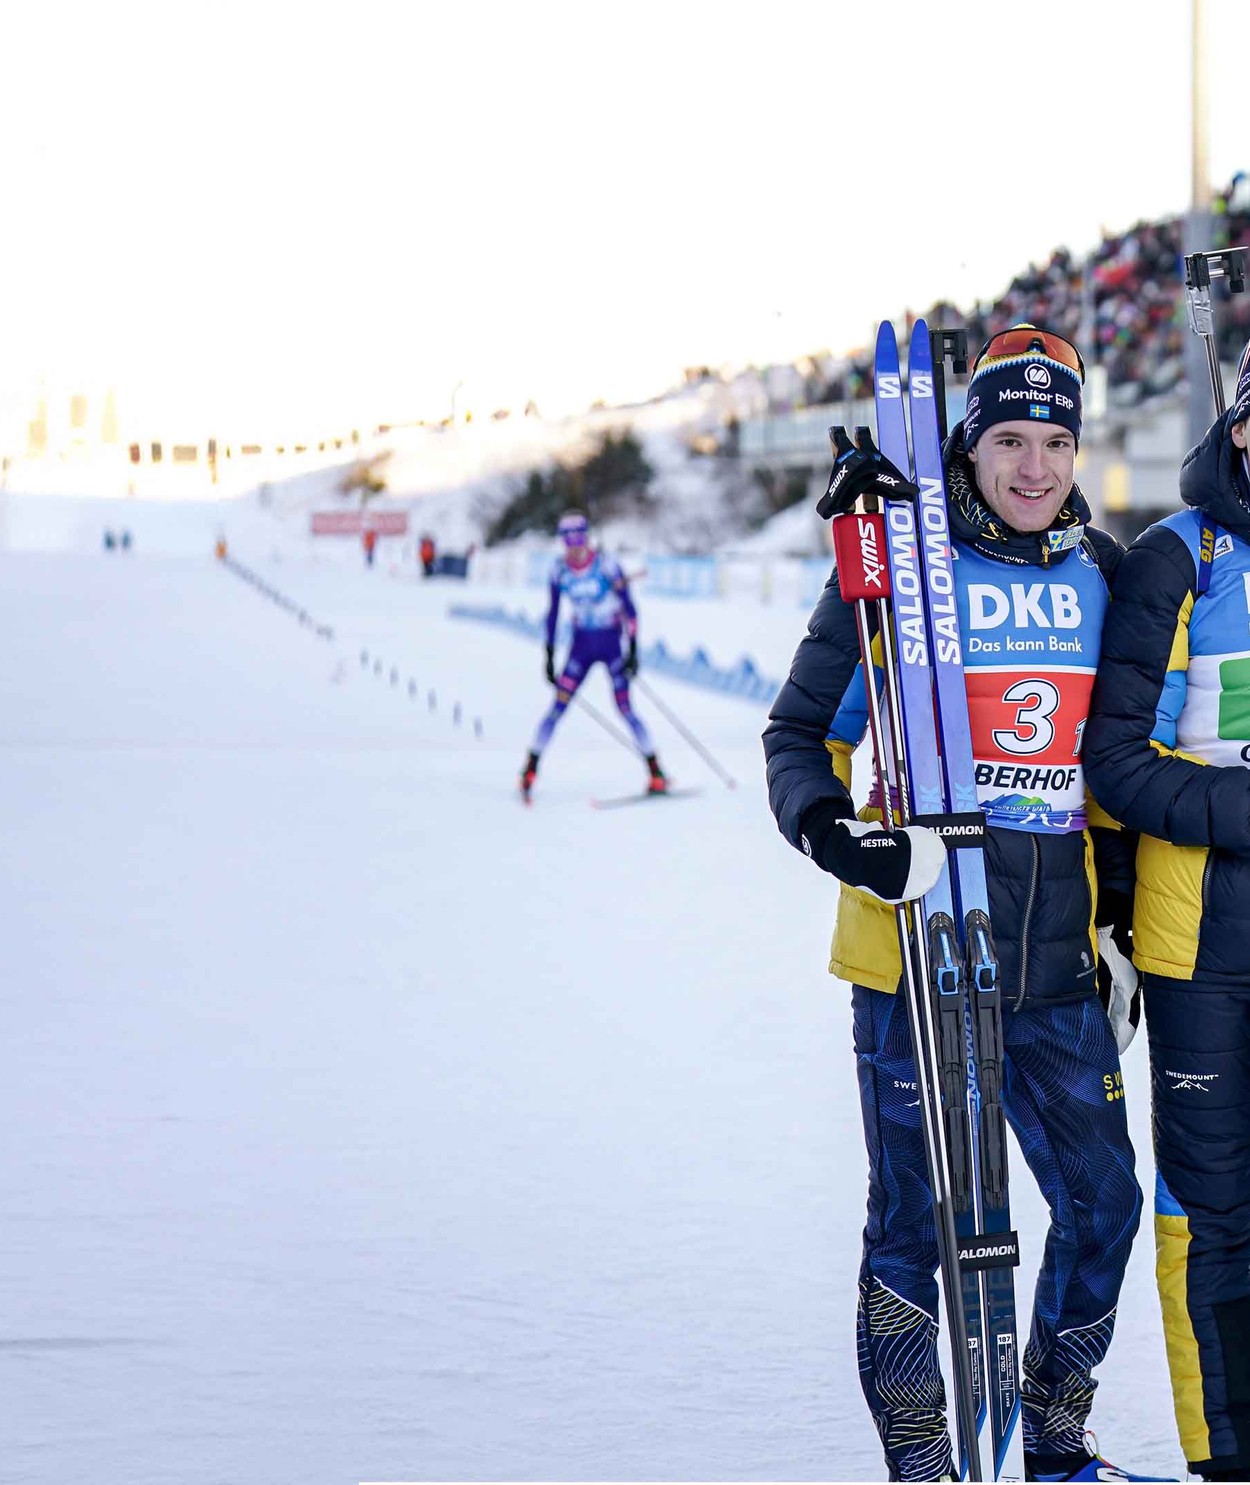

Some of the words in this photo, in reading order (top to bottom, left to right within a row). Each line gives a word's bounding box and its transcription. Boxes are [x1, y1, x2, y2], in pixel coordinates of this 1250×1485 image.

[999, 389, 1054, 402] Monitor
[1055, 393, 1074, 410] ERP
[829, 465, 848, 497] SWIX
[1201, 528, 1215, 564] ATG
[888, 500, 927, 667] SALOMO
[919, 477, 961, 666] SALOMON
[967, 583, 1082, 630] DKB
[968, 636, 1001, 653] Das
[1006, 636, 1045, 652] kann
[1049, 636, 1083, 653] Bank
[992, 678, 1060, 756] 3
[975, 764, 1077, 791] BERHOF
[861, 838, 897, 849] HESTRA
[930, 825, 984, 837] ALOMON
[958, 1244, 1017, 1260] ALOMON
[998, 1335, 1011, 1343] 187
